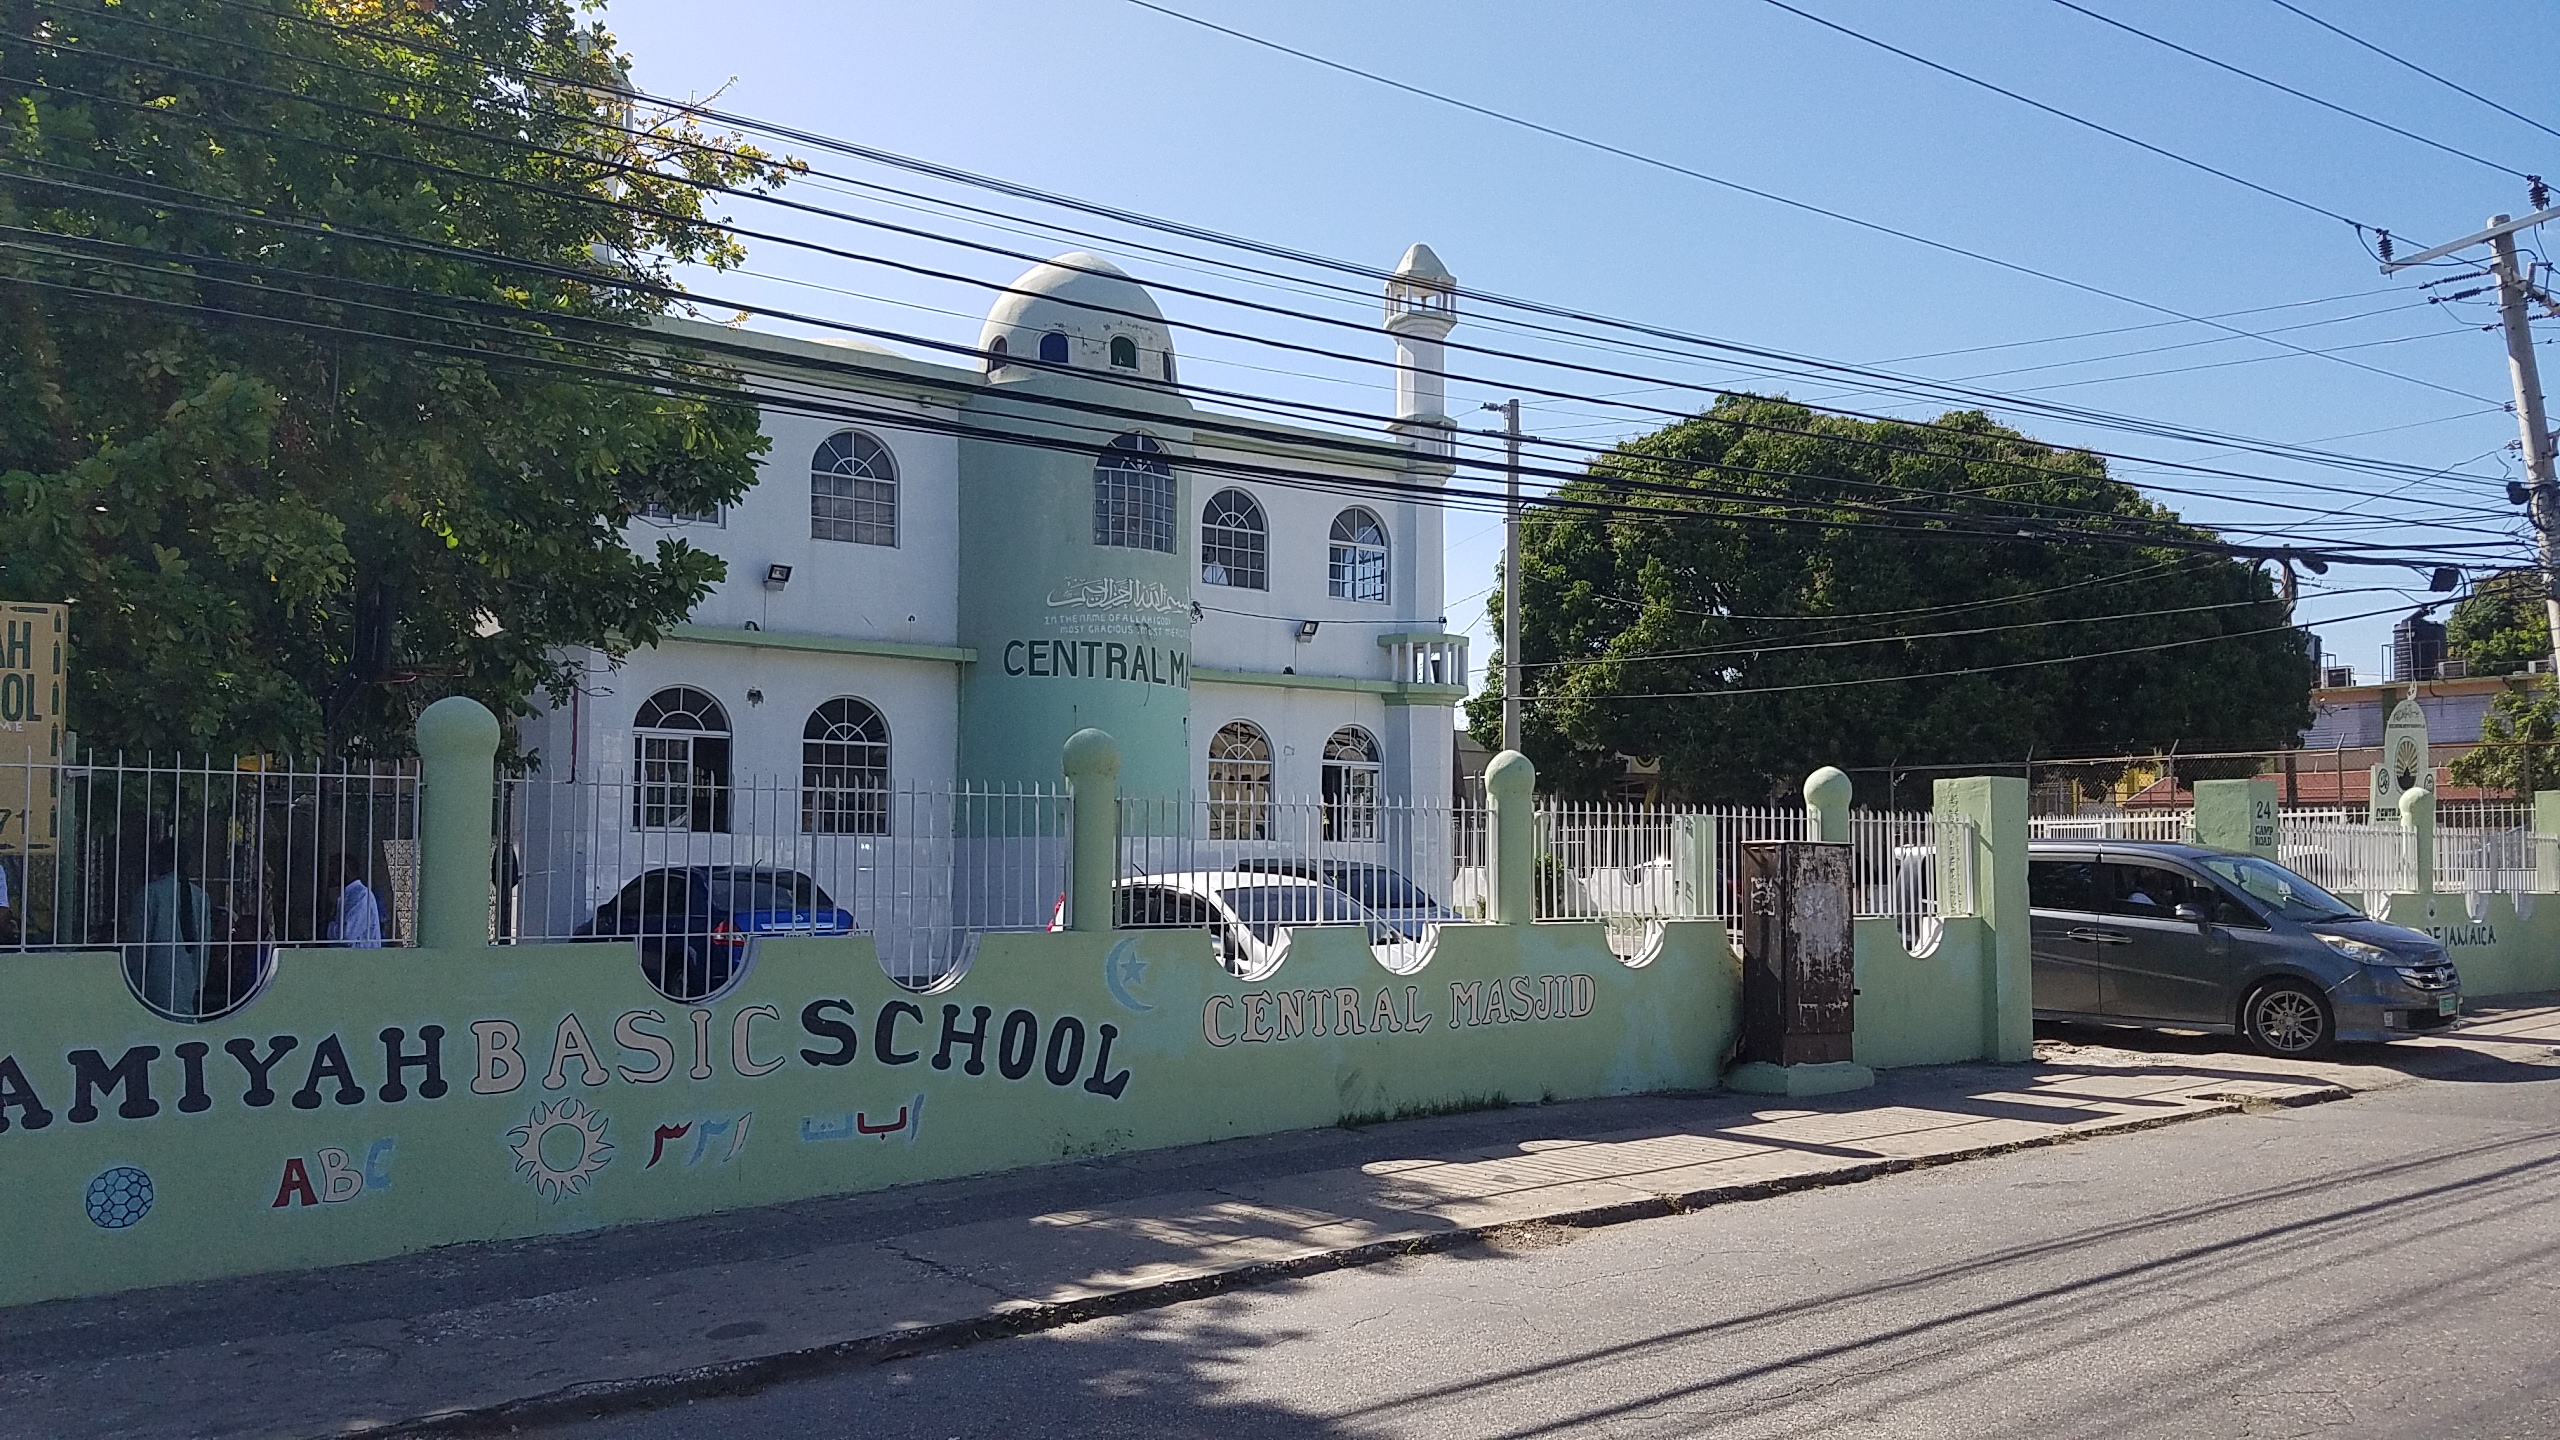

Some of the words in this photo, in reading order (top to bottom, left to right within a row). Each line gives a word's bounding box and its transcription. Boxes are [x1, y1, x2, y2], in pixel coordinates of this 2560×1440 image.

[1060, 615, 1078, 624] THE
[1108, 613, 1120, 623] OF
[1060, 625, 1084, 634] MOST
[1088, 624, 1133, 635] GRACIOUS
[0, 619, 32, 670] H
[1003, 639, 1167, 685] CENTRAL
[2256, 800, 2272, 820] 24
[2254, 825, 2274, 836] CAMP
[2443, 924, 2497, 949] JAMAICA
[1202, 985, 1433, 1048] CENTRAL
[1449, 973, 1597, 1030] MASJID
[470, 1004, 786, 1095] BASIC
[799, 998, 1131, 1101] SCHOOL
[271, 1136, 395, 1209] ABC
